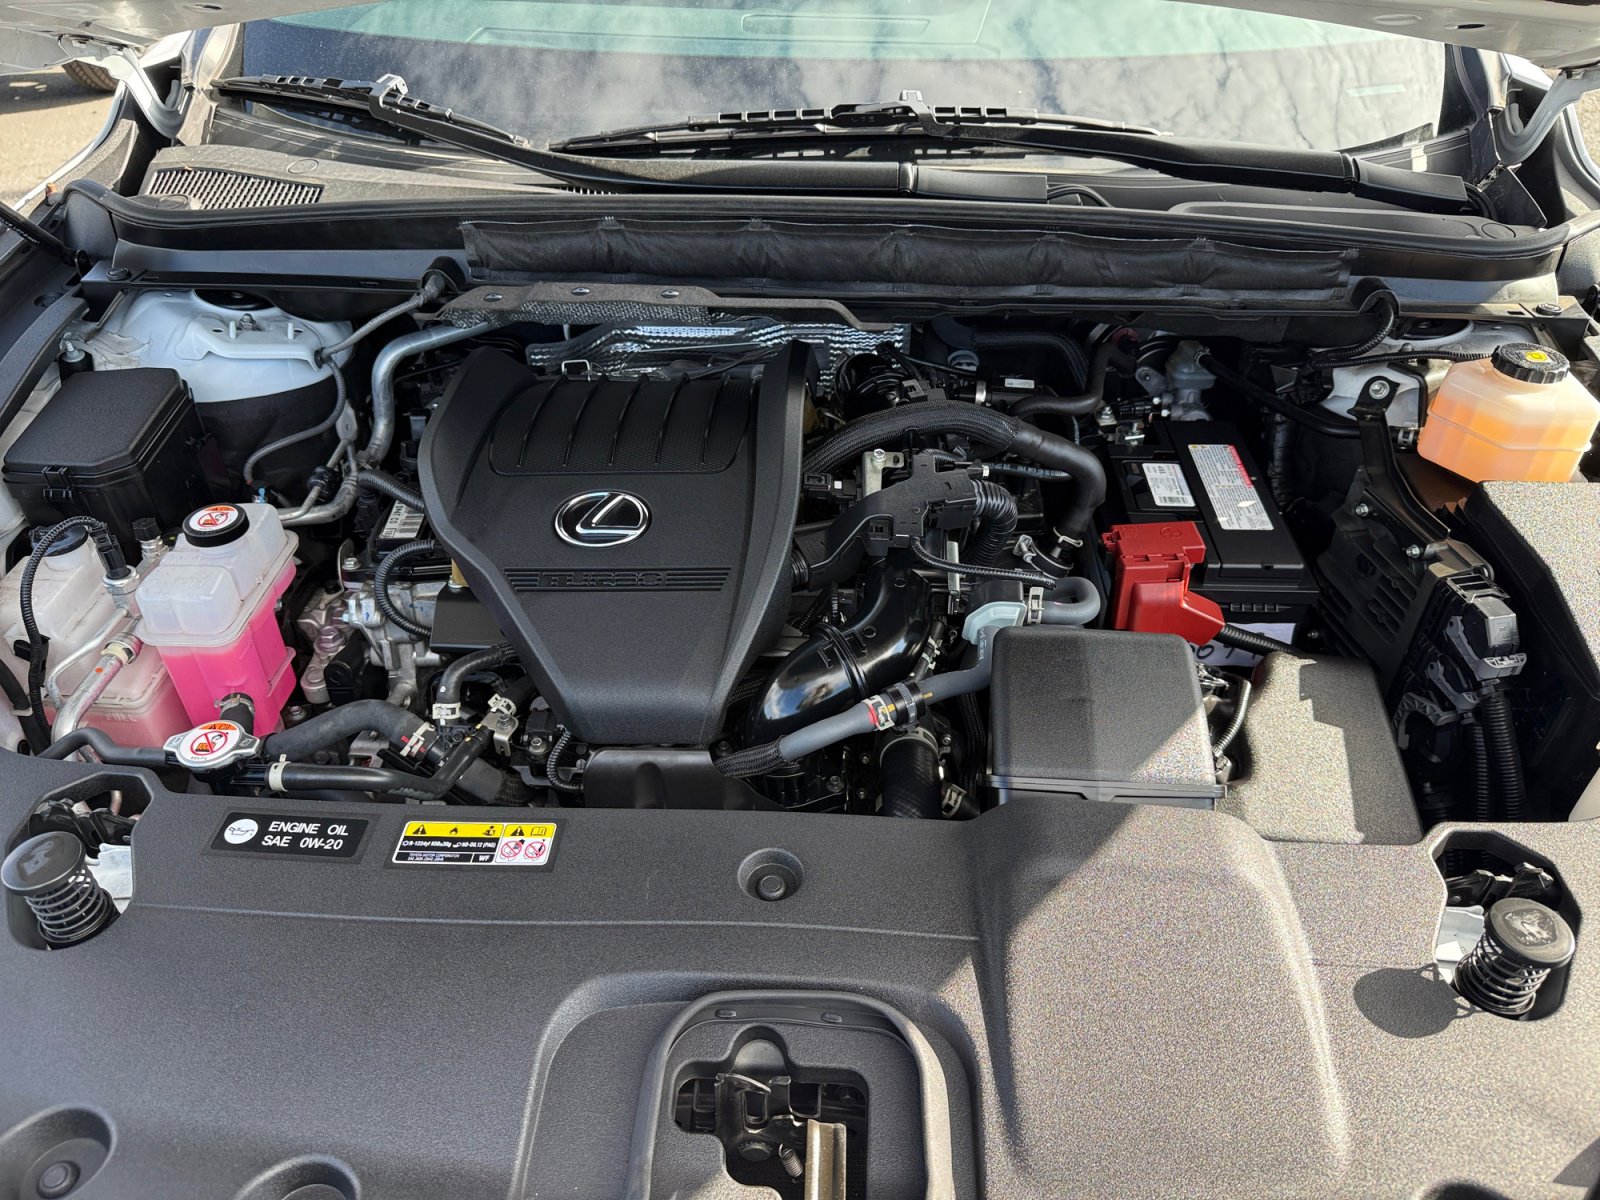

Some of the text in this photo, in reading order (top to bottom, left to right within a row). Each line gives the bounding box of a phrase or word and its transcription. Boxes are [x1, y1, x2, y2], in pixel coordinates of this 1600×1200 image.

[542, 571, 664, 587] TURBO
[268, 821, 349, 836] ENGINE OIL
[261, 834, 344, 850] SAE 0W-20
